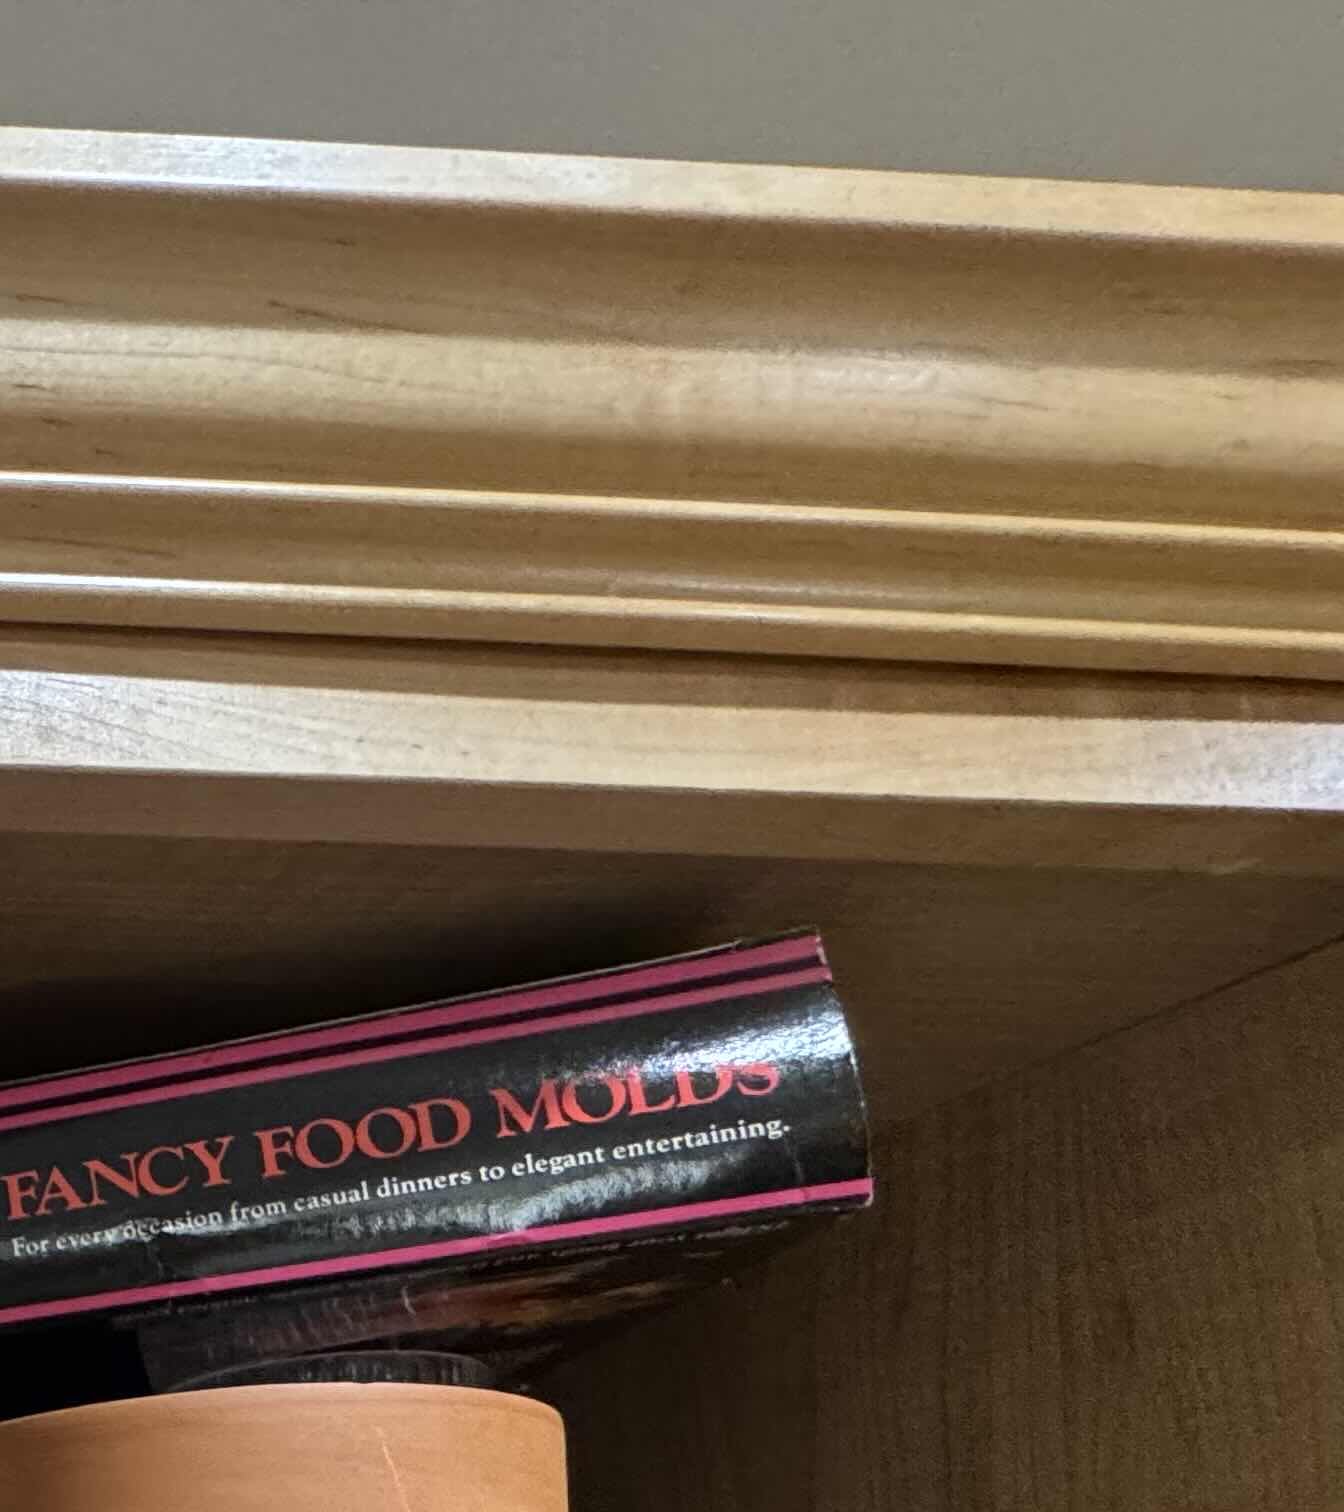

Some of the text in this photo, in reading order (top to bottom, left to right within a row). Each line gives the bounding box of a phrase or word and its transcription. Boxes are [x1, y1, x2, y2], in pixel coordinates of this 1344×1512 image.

[0, 1057, 782, 1220] FANCY FOOD MOLDS
[11, 1118, 792, 1258] For every occasion from casual dinners to elegant entertaining.
